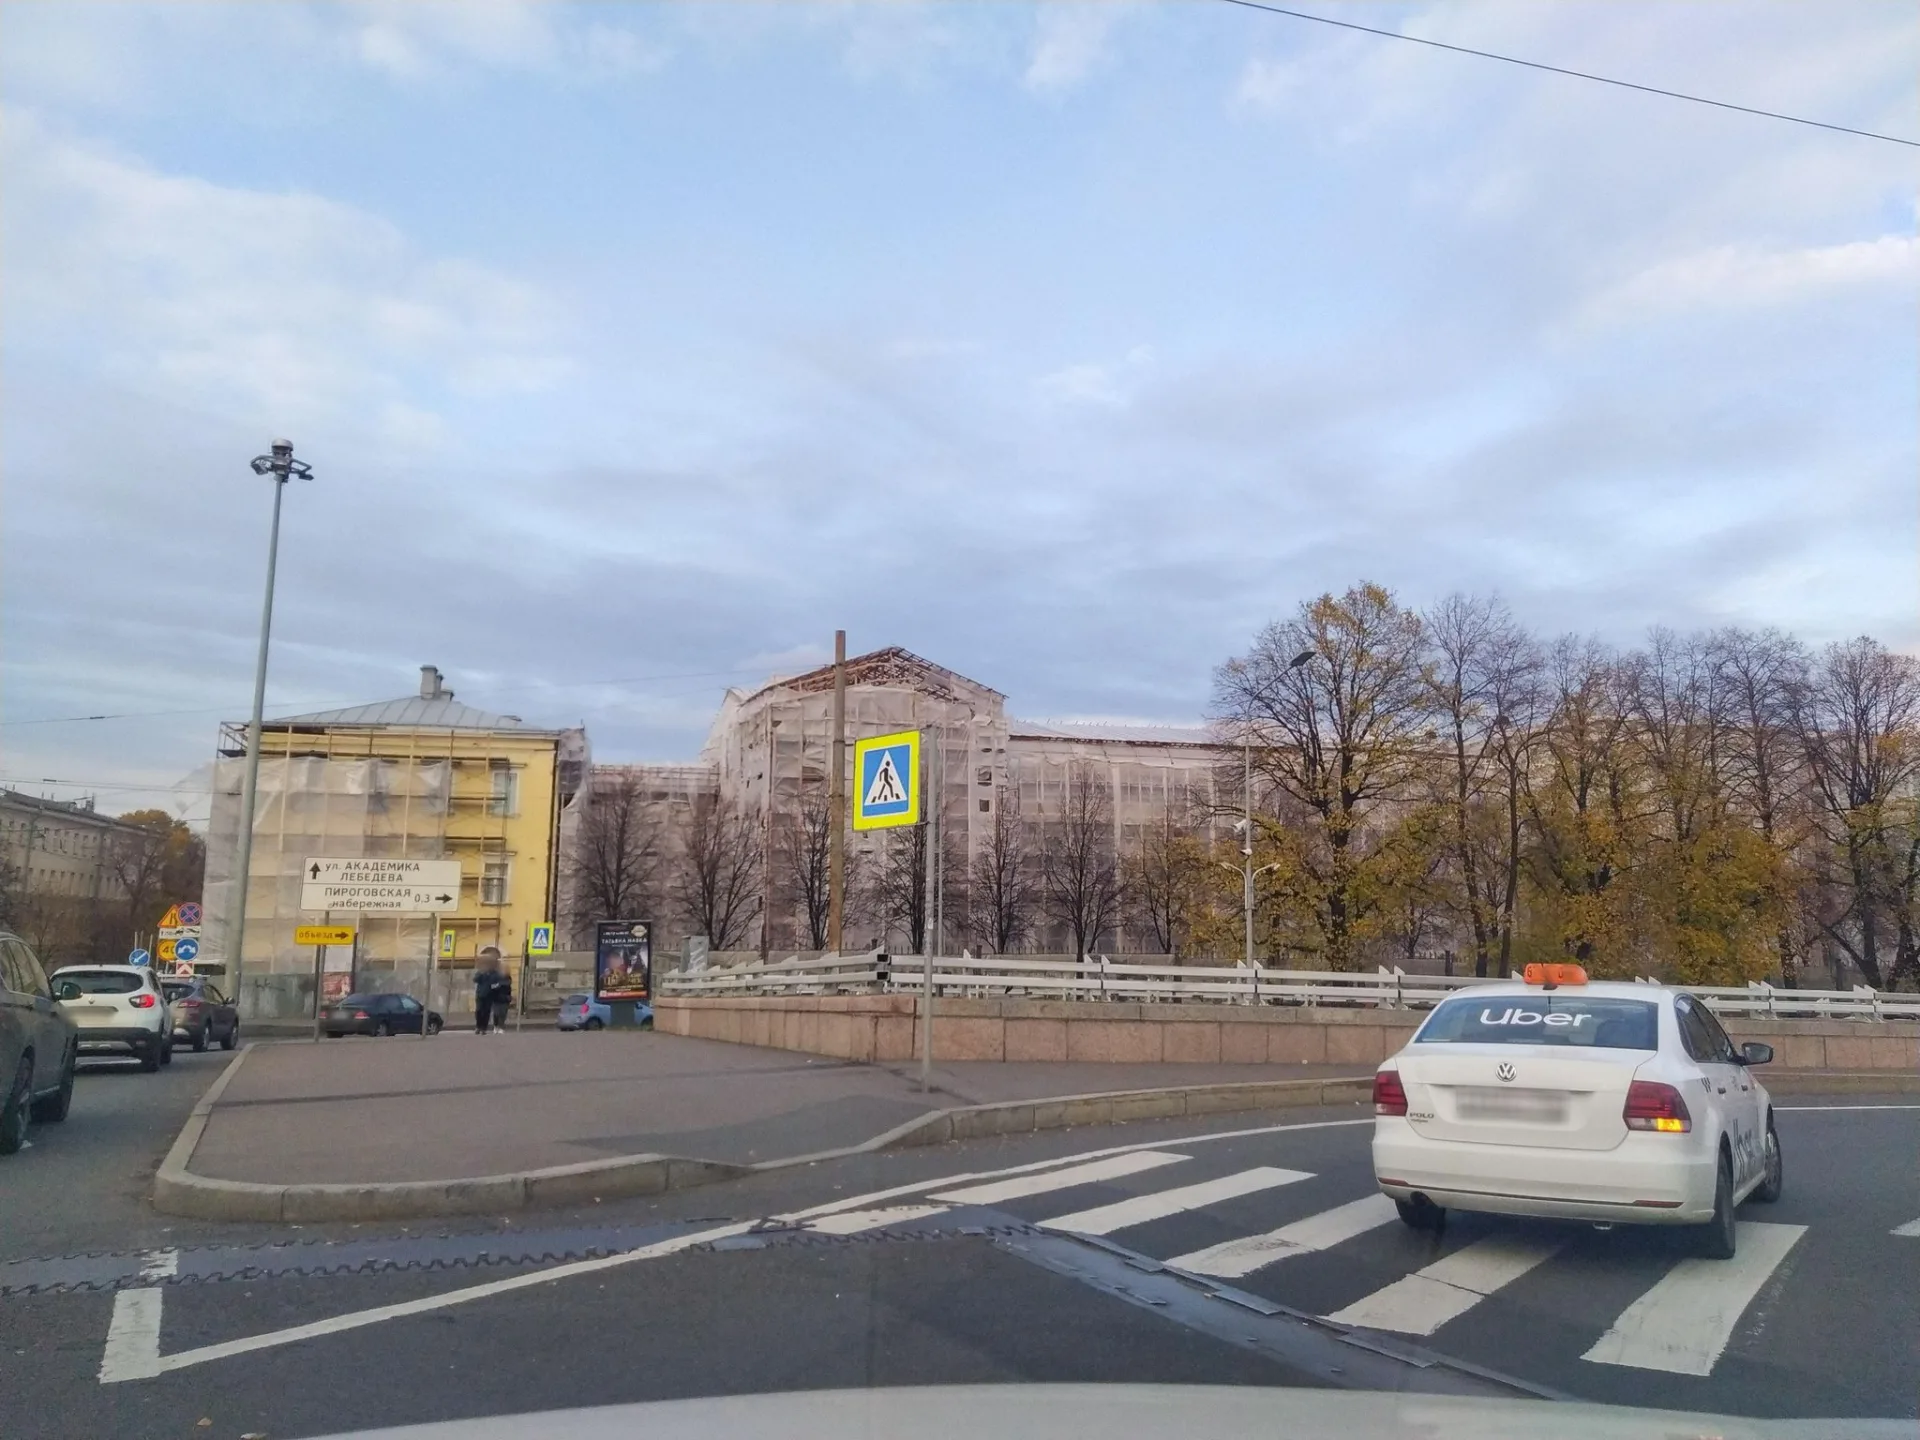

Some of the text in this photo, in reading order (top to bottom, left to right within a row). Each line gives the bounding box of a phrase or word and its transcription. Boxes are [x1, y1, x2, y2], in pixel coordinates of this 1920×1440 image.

[325, 862, 420, 872] ул. АКАДЕМИКА
[340, 872, 403, 882] ЛЕБЕДЕВА
[324, 887, 411, 897] ПИРОГОВСКАЯ
[332, 899, 401, 909] набережная
[298, 931, 332, 939] объезд
[1480, 1008, 1592, 1027] Uber
